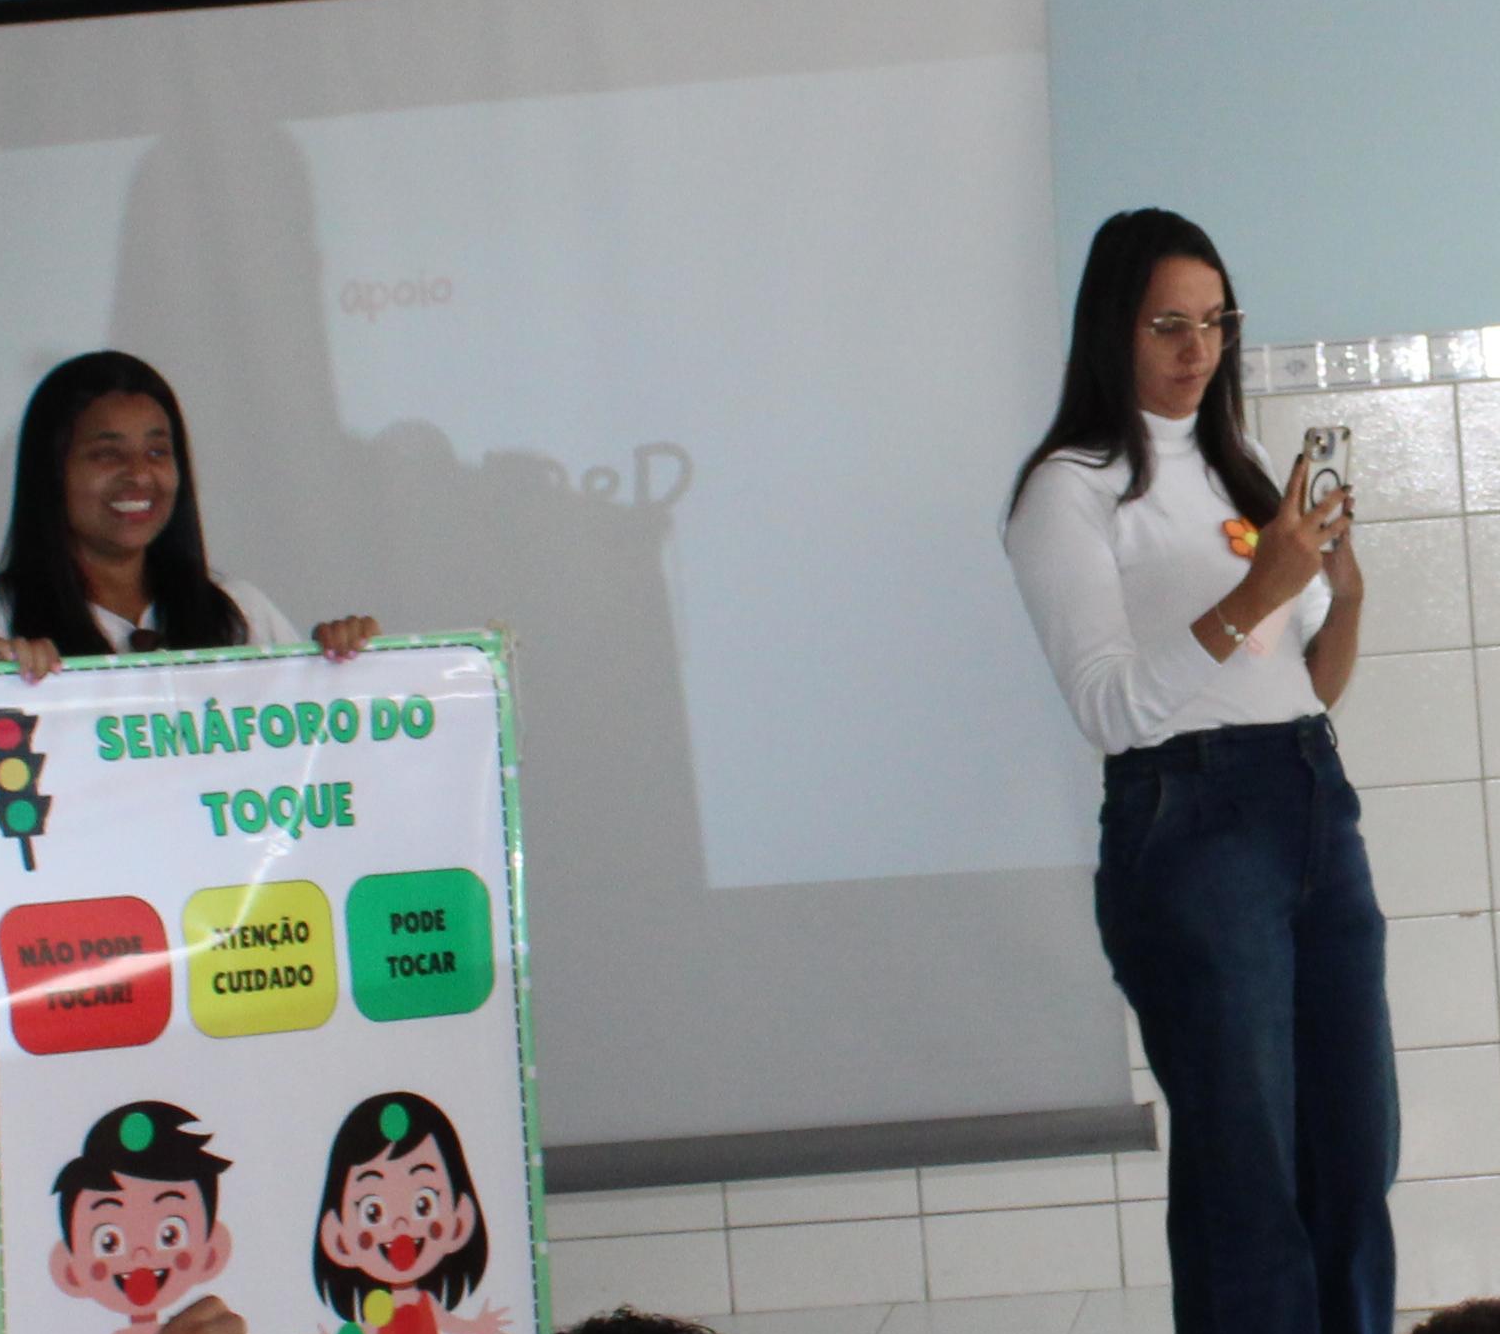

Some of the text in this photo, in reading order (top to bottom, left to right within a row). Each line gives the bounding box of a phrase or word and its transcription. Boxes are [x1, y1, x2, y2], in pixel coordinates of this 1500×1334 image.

[339, 270, 453, 323] apoio
[96, 694, 435, 761] SEMÁFORO DO
[200, 781, 357, 840] TOQUE
[390, 908, 447, 935] PODE
[18, 937, 75, 968] NÃO
[386, 950, 457, 979] TOCAR
[212, 963, 314, 996] CUIDADO
